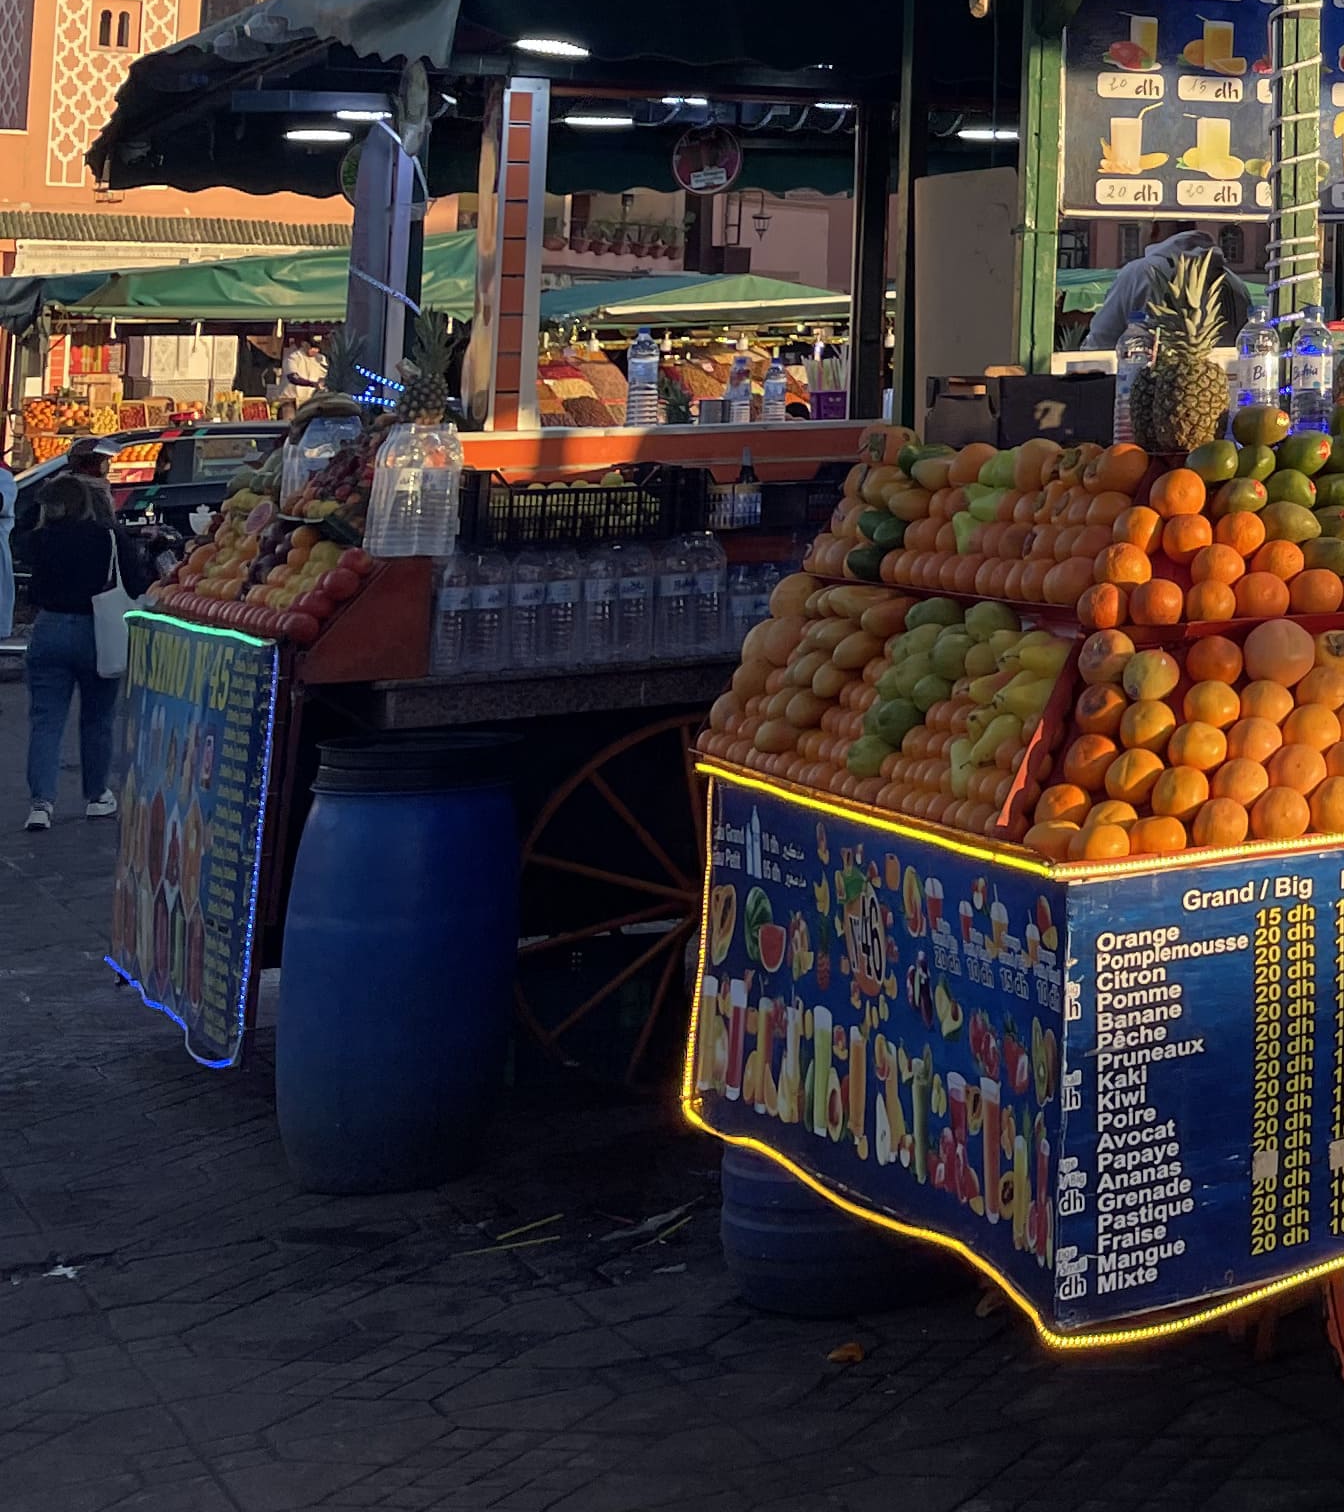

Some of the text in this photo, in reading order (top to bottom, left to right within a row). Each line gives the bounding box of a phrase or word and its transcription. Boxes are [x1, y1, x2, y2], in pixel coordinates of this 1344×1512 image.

[1134, 79, 1160, 97] dh
[1214, 82, 1240, 100] dh
[1133, 185, 1159, 203] dh
[1213, 186, 1239, 204] dh
[1182, 881, 1254, 911] Grand
[1274, 875, 1313, 899] Big
[1255, 903, 1315, 927] 15 dh
[1096, 926, 1180, 952] Orange
[1096, 934, 1249, 973] Pomplemousse
[1096, 966, 1167, 992] Citron
[1097, 984, 1182, 1012] Pomme
[1097, 1003, 1182, 1033] Banane
[1097, 1025, 1167, 1053] Pêche
[1097, 1038, 1206, 1073] Pruneaux
[1097, 1064, 1147, 1093] Kaki
[1097, 1085, 1146, 1113] Kiwi
[1097, 1106, 1157, 1133] Poire
[1096, 1118, 1176, 1153] Avocat
[1097, 1141, 1180, 1173] Papaye
[1096, 1161, 1182, 1194] Ananas
[1060, 1190, 1084, 1214] dh
[1097, 1177, 1192, 1213] Grenade
[1097, 1197, 1195, 1234] Pastique
[1097, 1224, 1167, 1254] Fraise
[1251, 1226, 1310, 1256] 20 dh
[1097, 1239, 1186, 1274] Mangue
[1061, 1272, 1086, 1299] dh
[1097, 1266, 1158, 1295] Mixte
